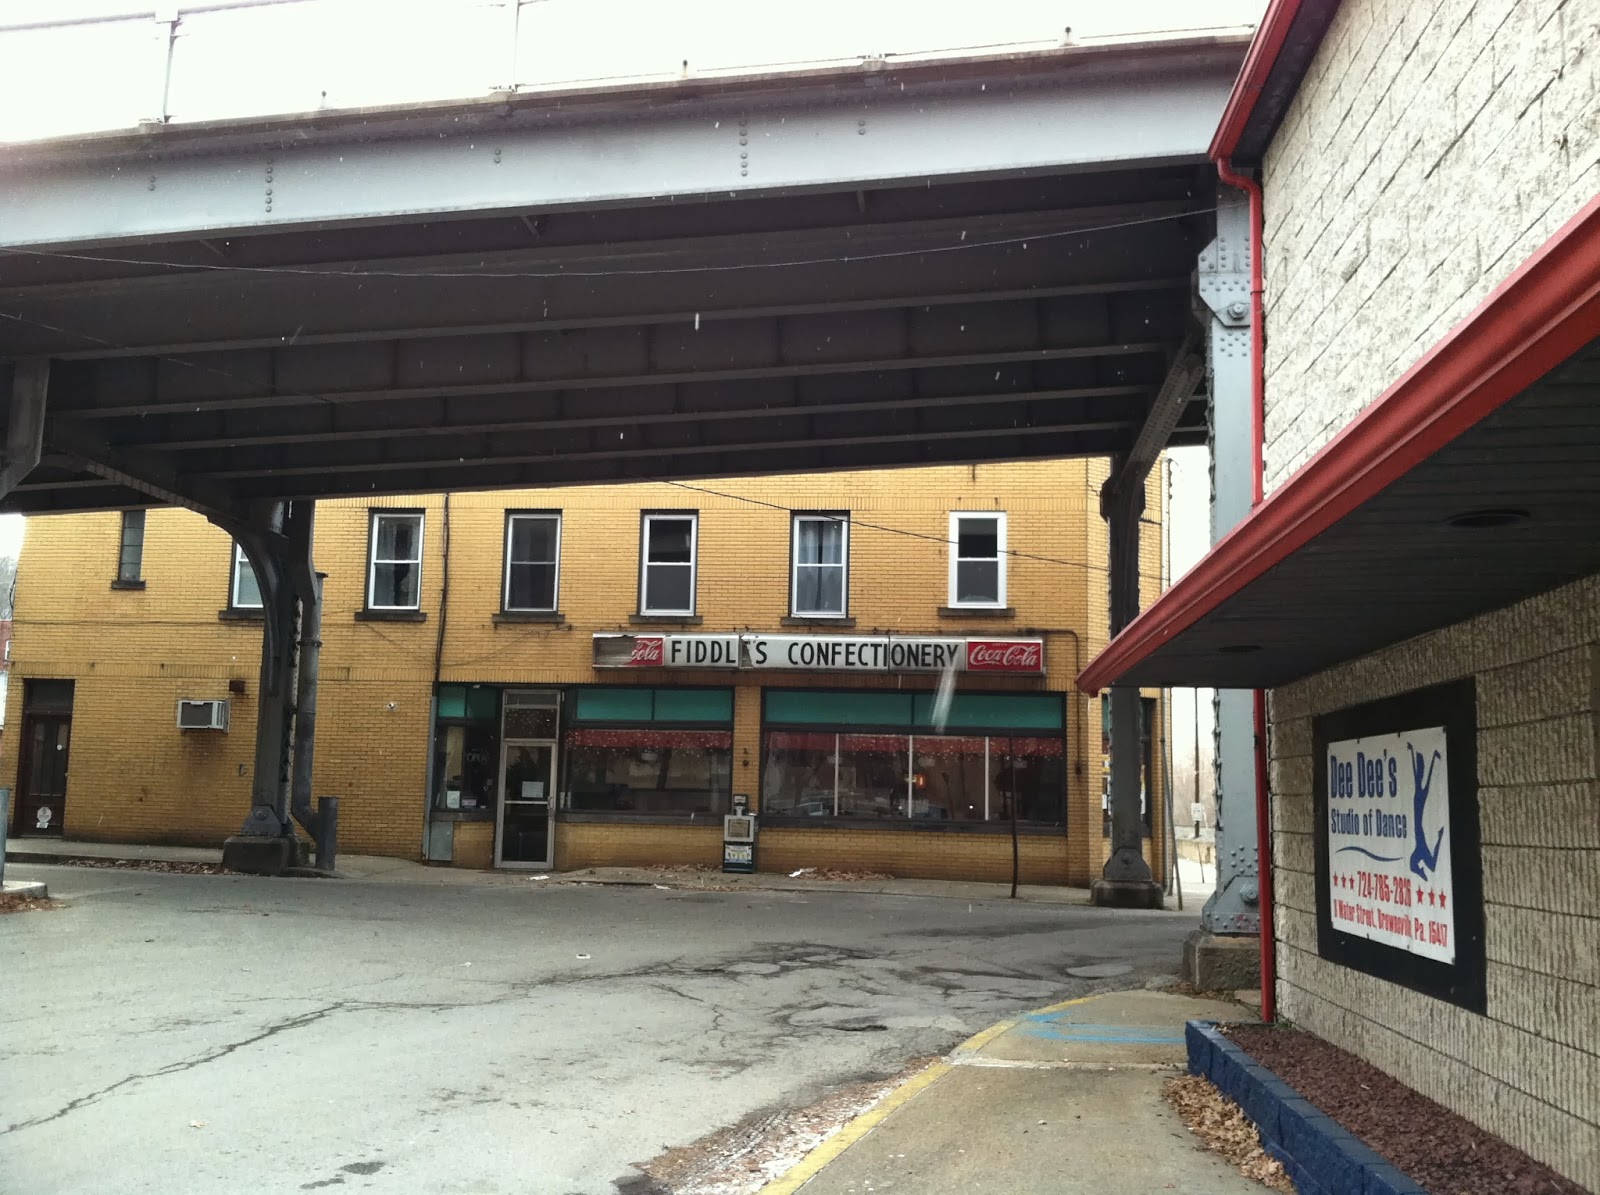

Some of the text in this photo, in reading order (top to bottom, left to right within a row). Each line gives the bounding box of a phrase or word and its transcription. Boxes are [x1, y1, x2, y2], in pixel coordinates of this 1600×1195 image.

[671, 640, 959, 667] FIDDLS CONFECTIONERY
[970, 645, 1040, 666] Coca-Cola
[1331, 749, 1397, 799] Dee Dee's
[1331, 808, 1407, 839] Studio of Dance
